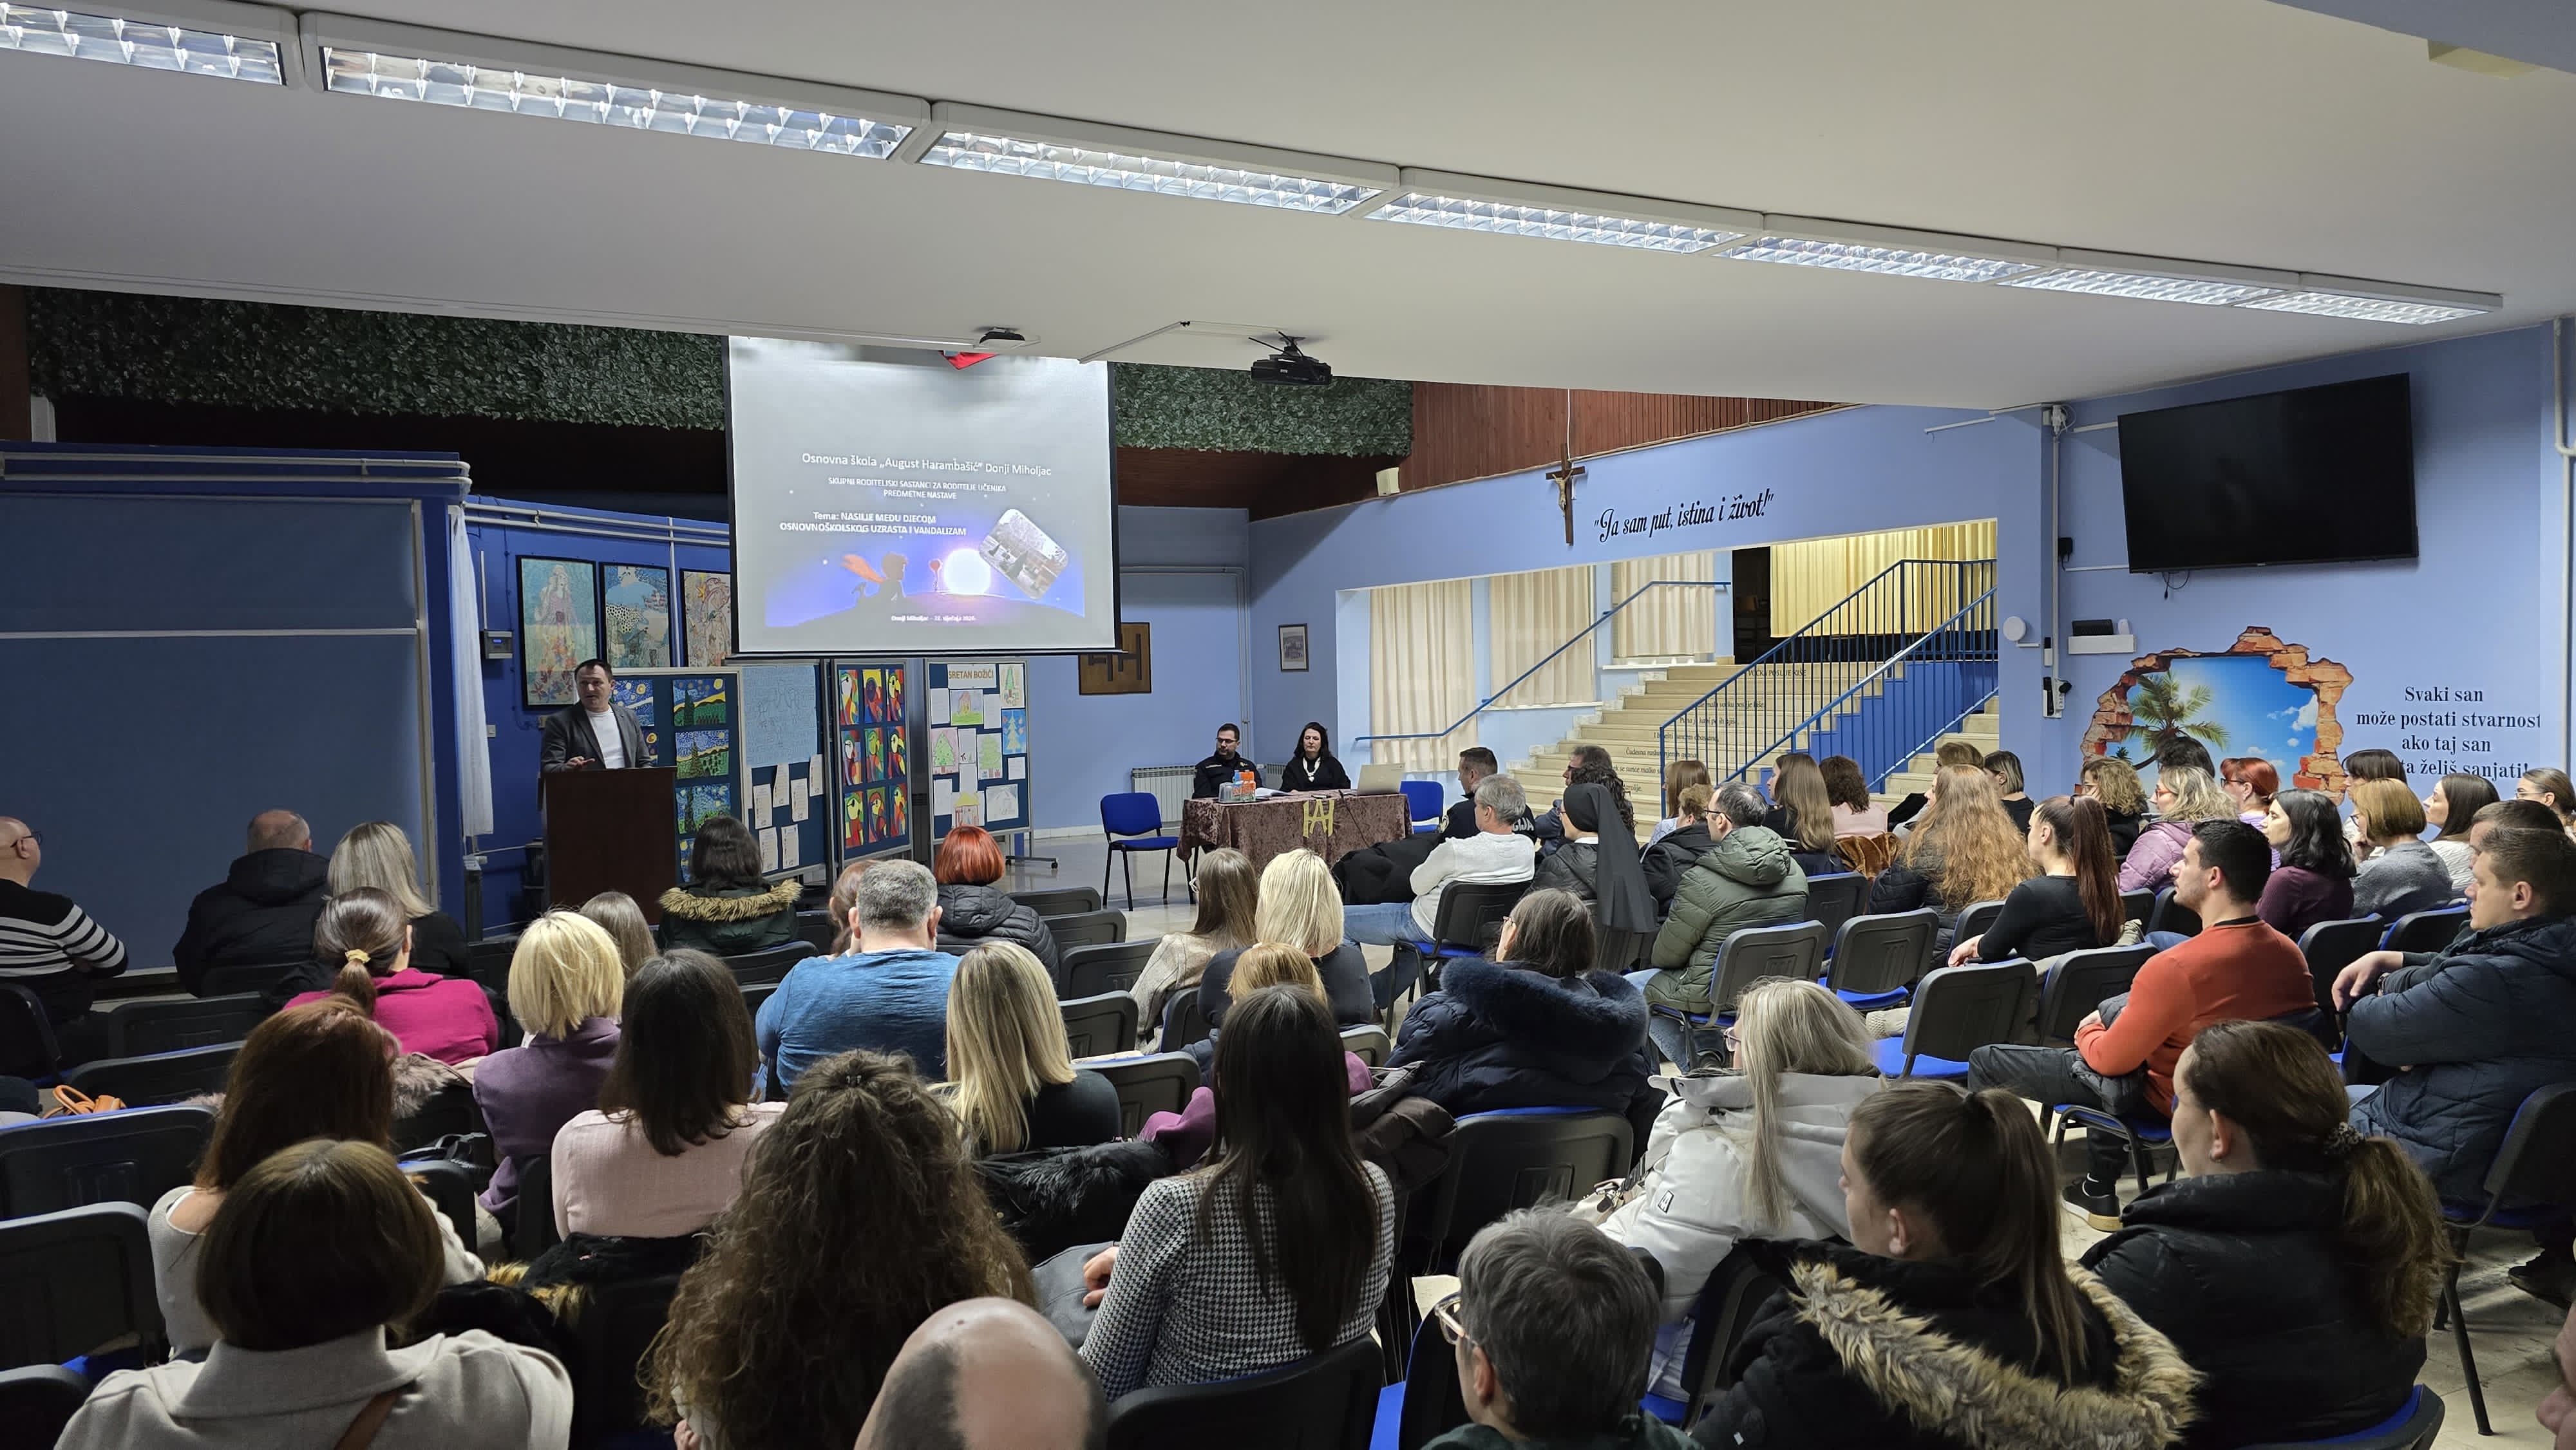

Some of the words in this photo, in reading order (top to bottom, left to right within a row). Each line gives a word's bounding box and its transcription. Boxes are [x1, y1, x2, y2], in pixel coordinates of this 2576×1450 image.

[802, 453, 848, 465] Osnovna
[850, 455, 877, 467] škola
[985, 463, 1010, 475] Donji
[1012, 464, 1052, 477] Miholjac
[828, 477, 855, 485] SKUPNI
[978, 484, 1007, 493] UČENIKA
[883, 489, 926, 498] PREDMETNE
[927, 491, 958, 500] NASTAVE
[813, 511, 840, 520] Tema:
[840, 512, 874, 522] NASILJE
[903, 514, 936, 524] DJECOM
[1622, 516, 1647, 536] sam
[1649, 506, 1674, 538] put,
[1677, 500, 1715, 527] istina
[1718, 496, 1726, 522] i
[779, 522, 869, 532] OSNOVNOŠKOLSKOG
[871, 525, 907, 534] UZRASTA
[914, 526, 967, 536] VANDALIZAM
[948, 670, 972, 679] SRETAN
[2404, 686, 2448, 702] Svaki
[2454, 689, 2484, 702] san
[2356, 710, 2396, 726] može
[2400, 711, 2457, 730] postati
[2462, 713, 2541, 729] stvarnost
[2401, 735, 2430, 751] ako
[2436, 735, 2457, 756] taj
[2462, 740, 2492, 753] san
[2420, 758, 2458, 775] želiš
